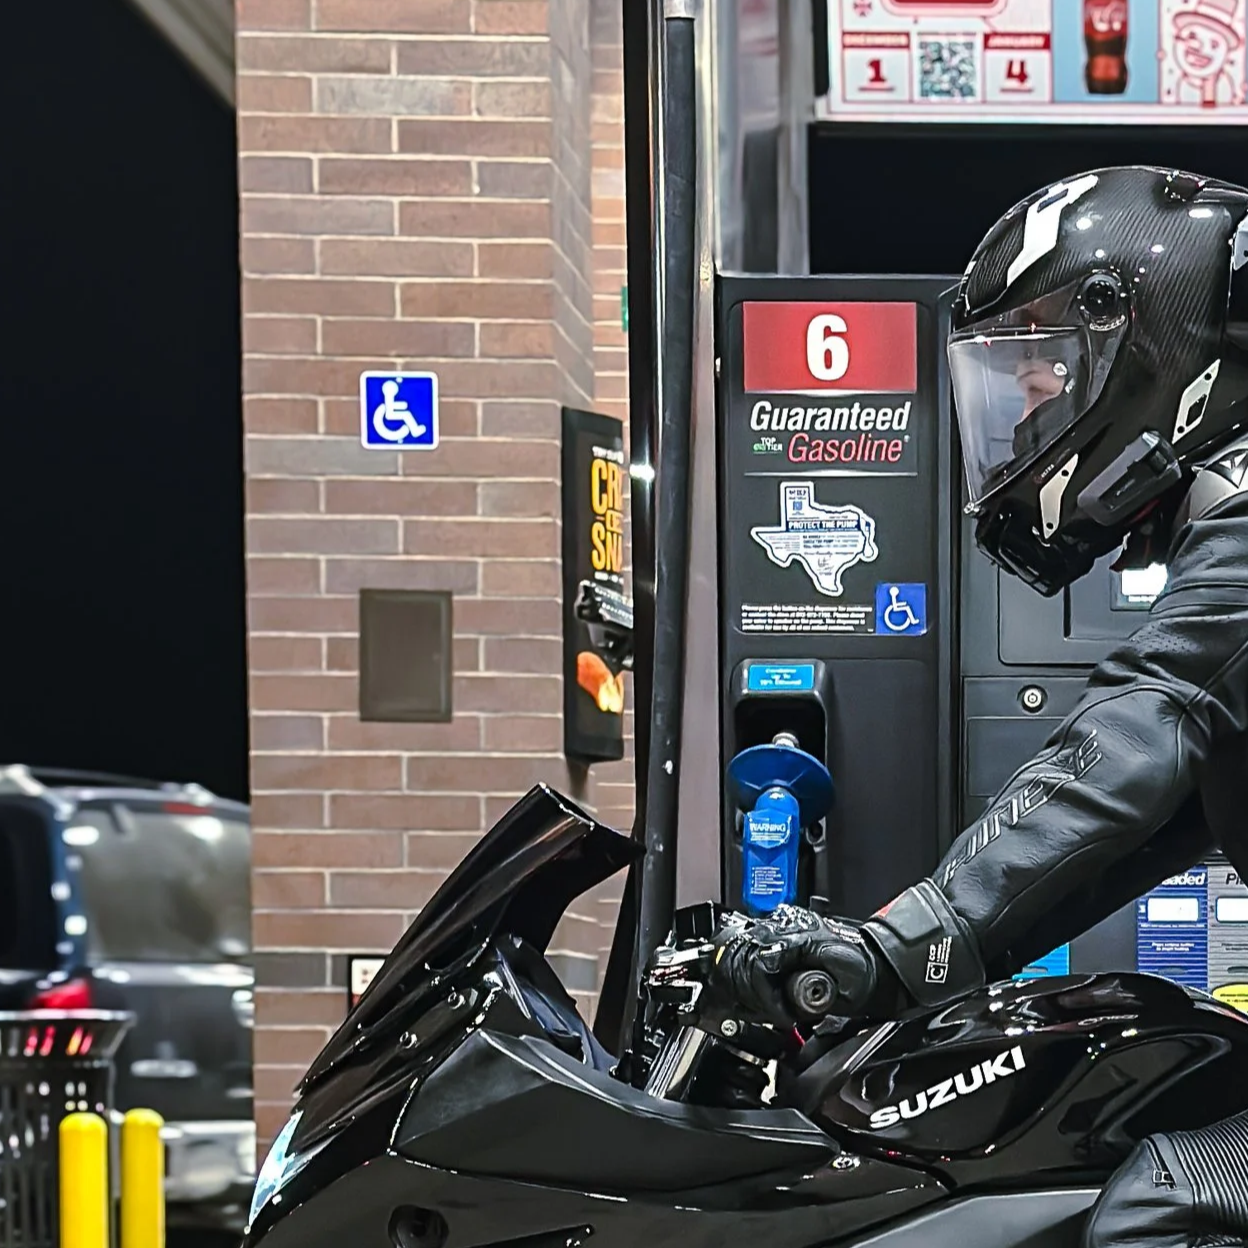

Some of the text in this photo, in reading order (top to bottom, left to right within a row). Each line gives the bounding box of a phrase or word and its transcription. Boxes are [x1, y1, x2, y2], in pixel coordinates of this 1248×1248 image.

[867, 59, 887, 83] 1
[1006, 59, 1029, 84] 4
[805, 313, 849, 381] 6
[750, 400, 911, 431] Guaranteed
[760, 437, 776, 445] TOP
[787, 432, 904, 463] Gasoline
[821, 520, 836, 530] THE
[749, 823, 786, 832] WARNING
[870, 1045, 1026, 1129] SUZUKI
